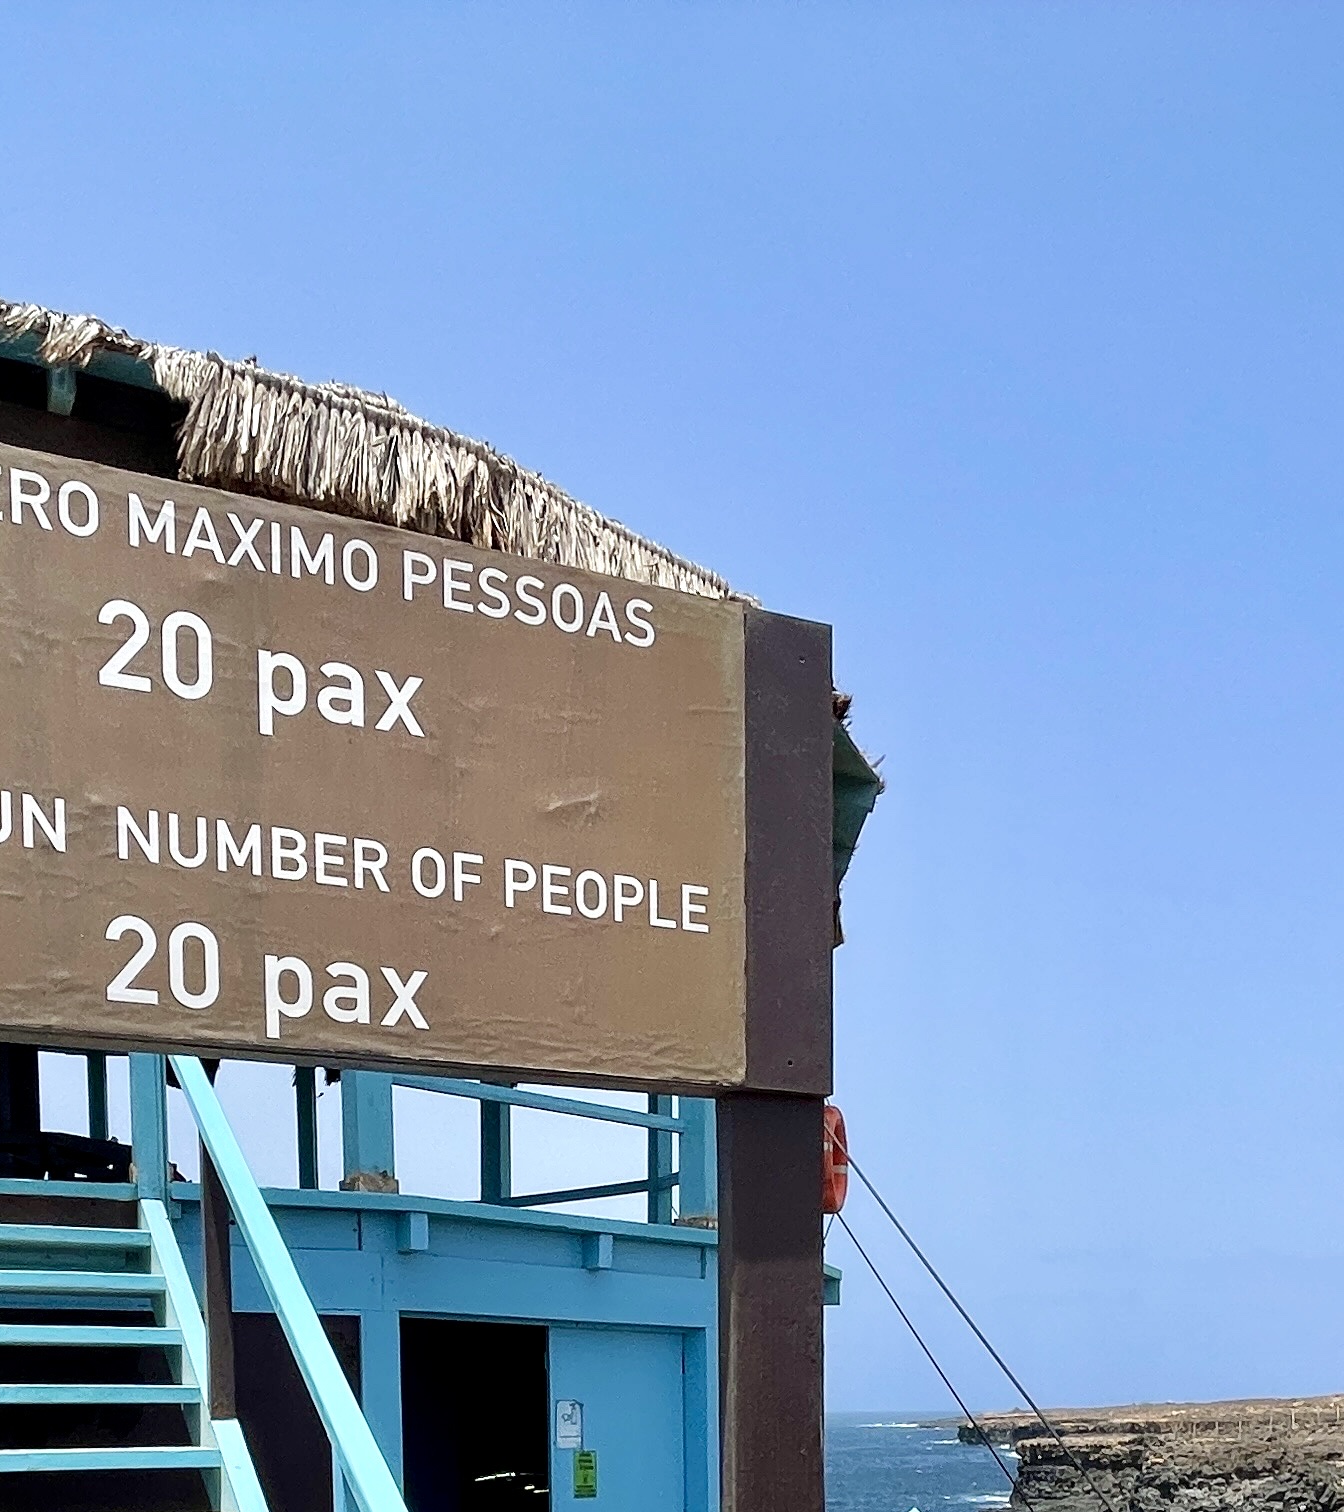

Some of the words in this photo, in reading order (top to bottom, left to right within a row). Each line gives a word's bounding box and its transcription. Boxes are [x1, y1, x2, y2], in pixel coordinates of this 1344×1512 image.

[127, 491, 379, 594] MAXIMO
[402, 548, 656, 649] PESSOAS
[97, 598, 214, 701] 20
[256, 648, 426, 738] pax
[116, 804, 391, 894] NUMBER
[410, 846, 485, 902] OF
[503, 857, 710, 934] PEOPLE
[104, 914, 221, 1010] 20
[263, 953, 431, 1041] pax
